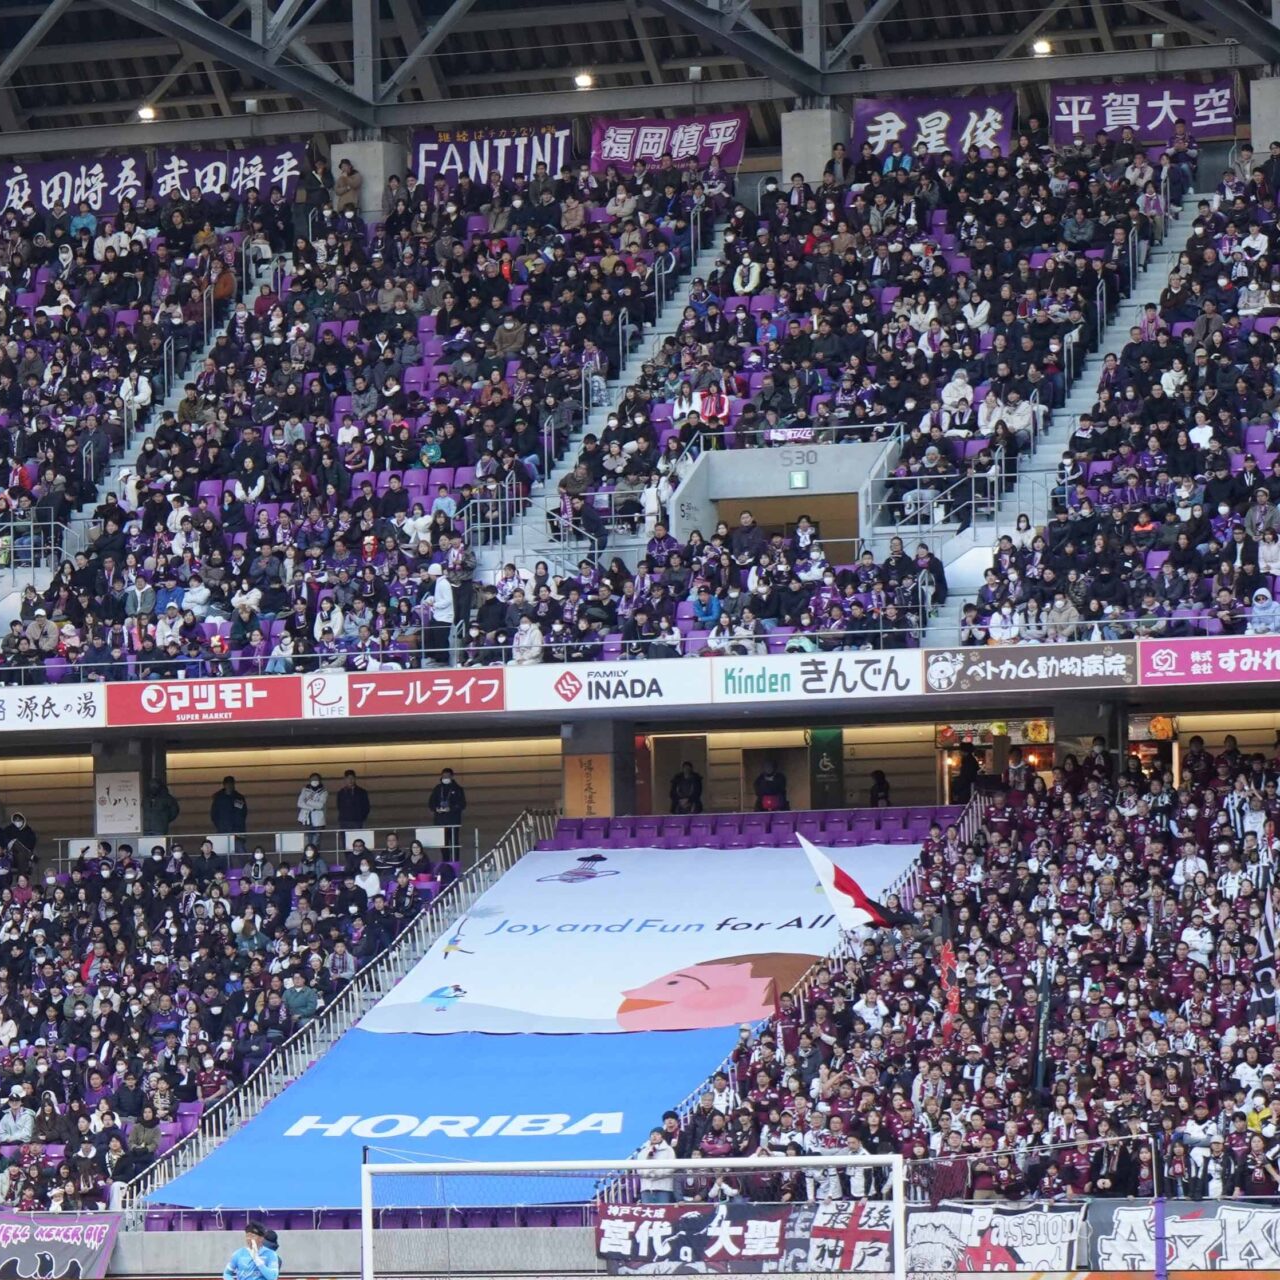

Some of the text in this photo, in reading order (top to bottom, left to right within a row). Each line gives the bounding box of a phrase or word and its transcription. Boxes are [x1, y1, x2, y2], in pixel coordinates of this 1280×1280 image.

[1054, 88, 1234, 134] 平賀大空
[601, 118, 741, 163] 福岡慎平
[417, 129, 570, 185] FANTINI
[156, 151, 301, 201] 武田将平
[779, 449, 818, 467] S30
[586, 670, 630, 680] FAMILY
[587, 677, 664, 701] INADA
[724, 666, 792, 696] Kinden
[800, 655, 911, 695] きんでん
[16, 688, 98, 721] 源氏の湯
[168, 682, 268, 712] マツモト
[352, 676, 501, 709] アールライフ
[176, 712, 233, 722] SUPER MARKET
[319, 706, 345, 717] LIFE
[485, 913, 837, 937] Joy and Fun for All
[283, 1112, 624, 1137] HORIBA
[822, 1201, 894, 1230] 最強
[34, 1225, 83, 1246] NEVER
[84, 1224, 109, 1250] DIE
[599, 1219, 673, 1258] 宮代
[704, 1218, 782, 1257] 大聖
[816, 1239, 883, 1271] 神戸
